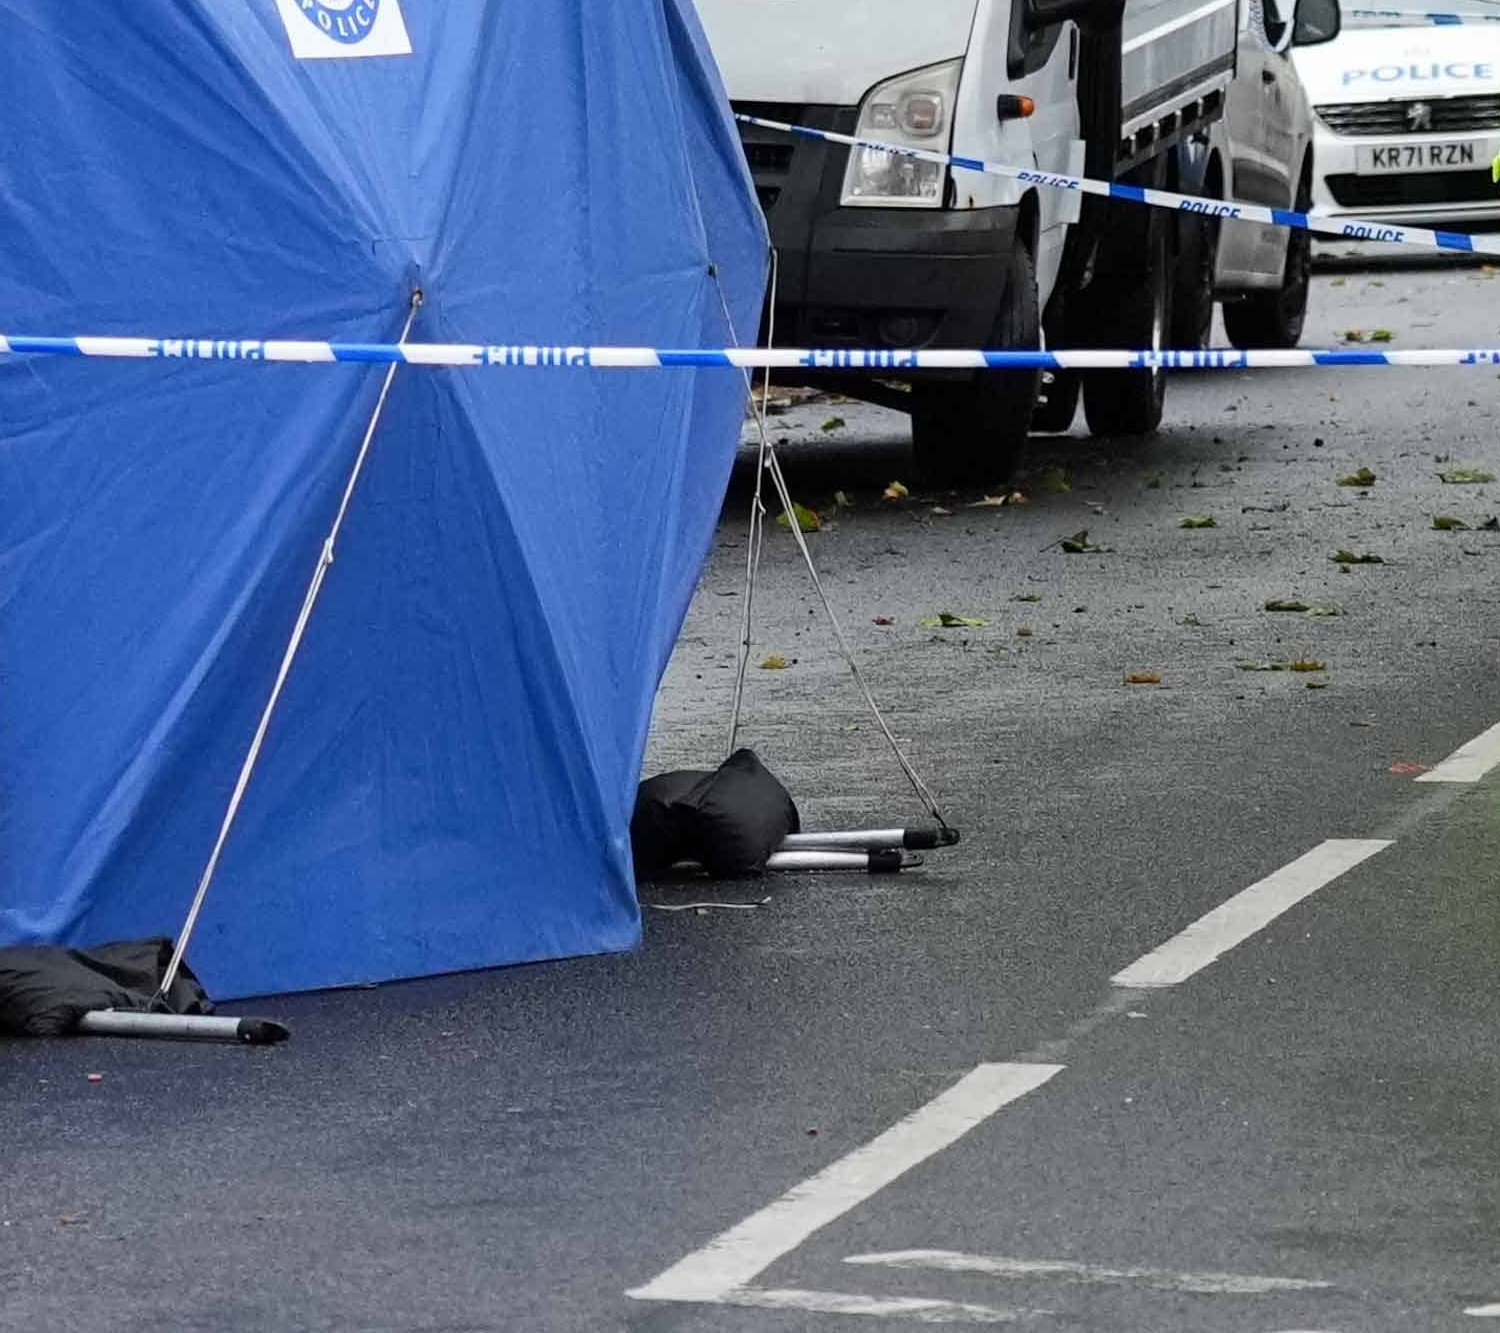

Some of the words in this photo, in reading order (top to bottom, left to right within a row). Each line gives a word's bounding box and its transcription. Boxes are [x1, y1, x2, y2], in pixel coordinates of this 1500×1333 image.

[1342, 63, 1494, 86] POLICE
[1372, 146, 1423, 169] KR71
[1430, 143, 1474, 165] RZN
[1343, 224, 1406, 244] POLICE
